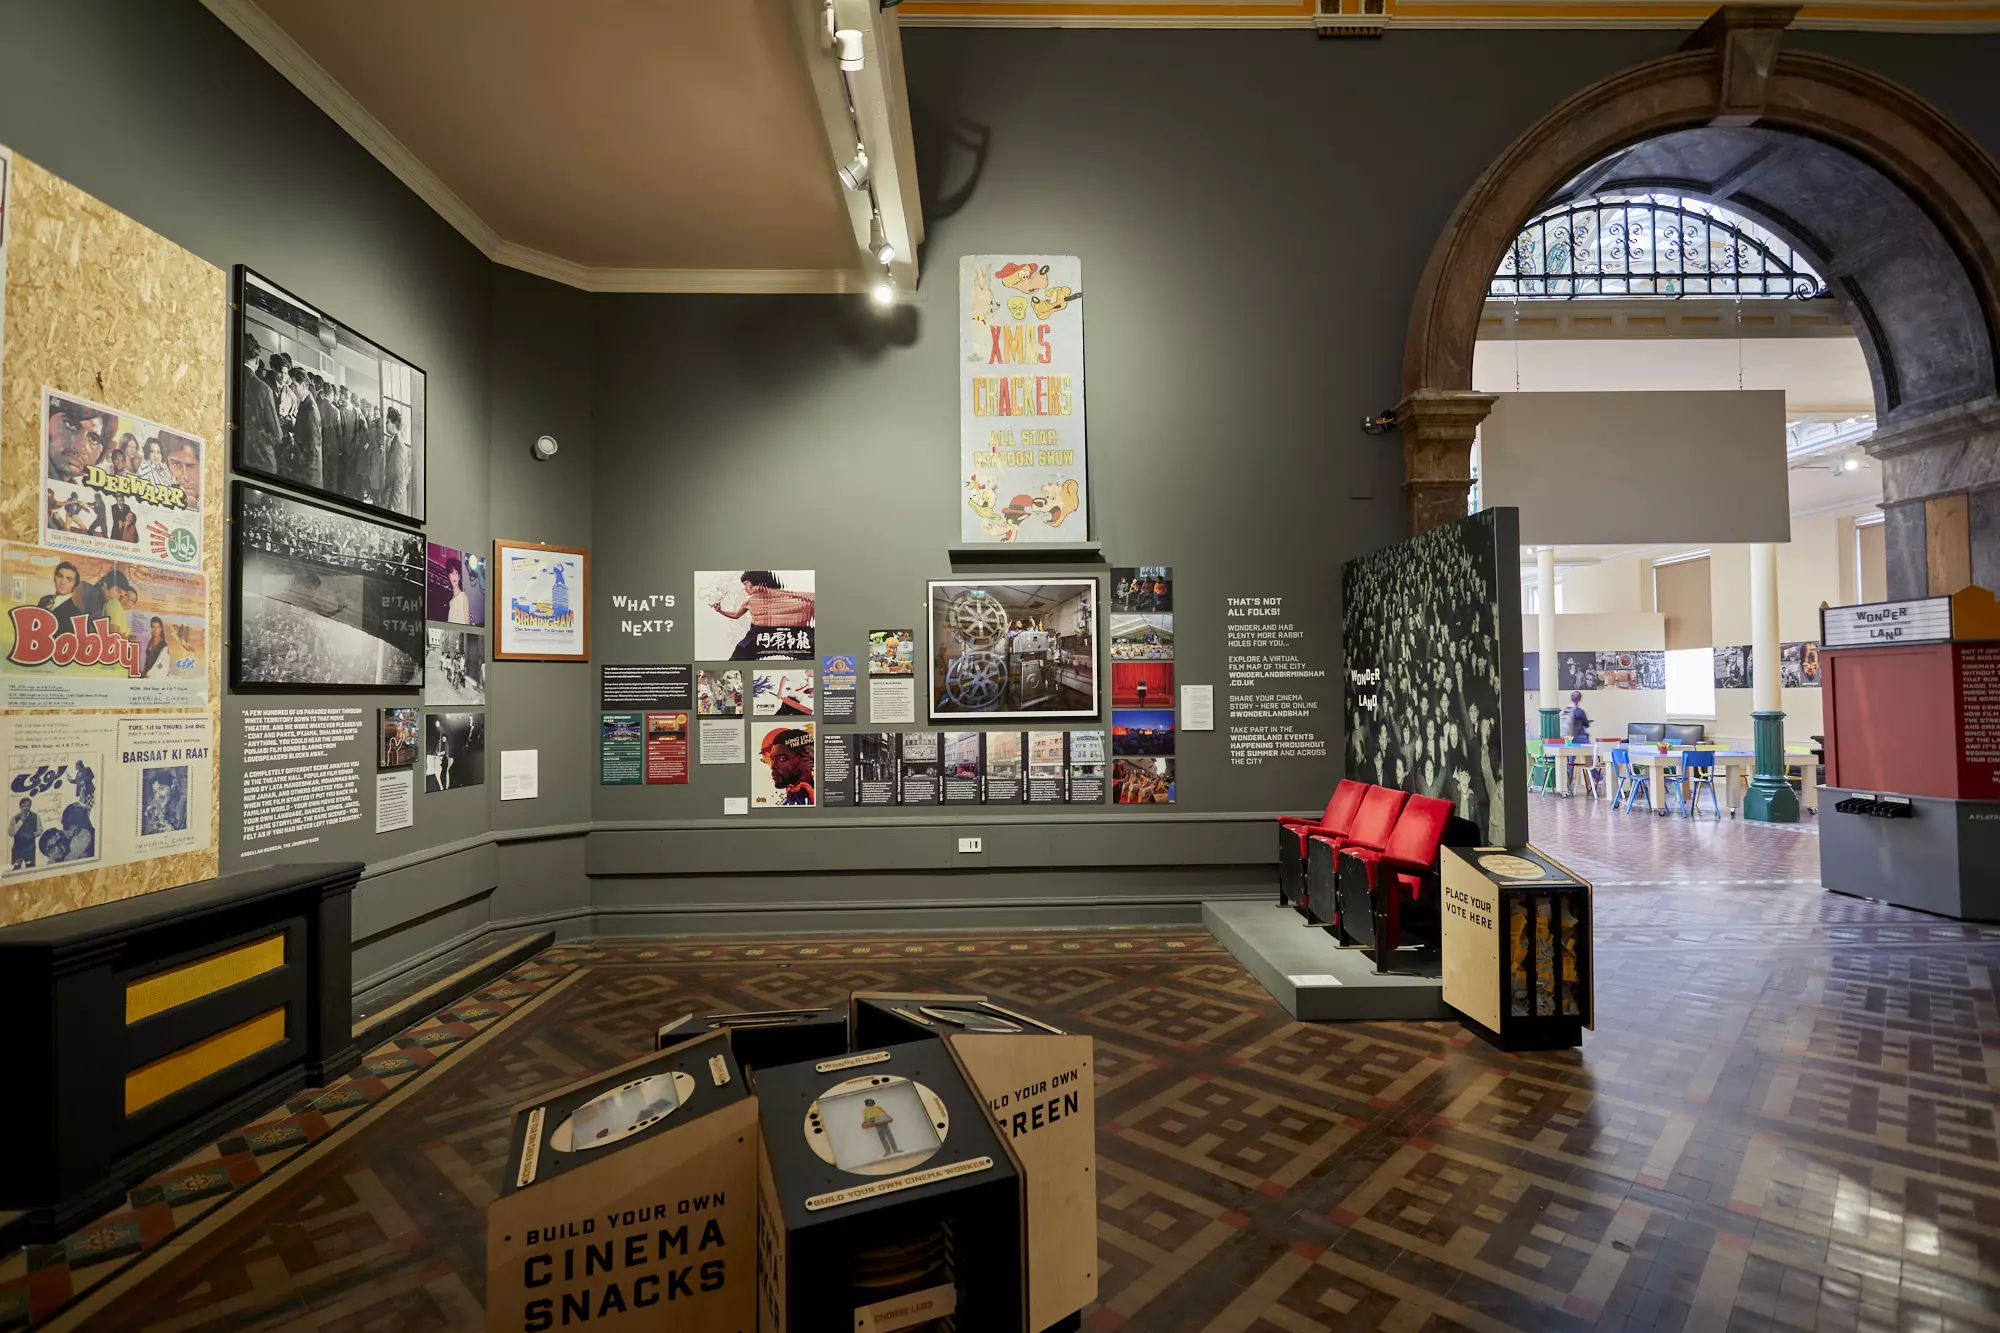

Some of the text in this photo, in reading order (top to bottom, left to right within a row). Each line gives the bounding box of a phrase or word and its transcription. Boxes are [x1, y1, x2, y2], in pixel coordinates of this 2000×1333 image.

[988, 323, 1052, 364] XMAS
[973, 374, 1072, 417] CRACKERS
[989, 429, 1058, 446] ALL STAR
[974, 450, 1074, 468] CARTOON SHOW
[84, 465, 187, 510] DEEWAAR
[612, 595, 675, 612] WHAT'S
[514, 608, 574, 628] BIRMINGHAM
[1856, 608, 1908, 622] WONDER
[622, 620, 674, 636] NEXT?
[1870, 628, 1902, 640] LAND
[8, 605, 141, 678] Bobby
[1352, 668, 1380, 686] WONDER
[1358, 695, 1377, 711] LAND
[785, 736, 799, 745] LONG
[123, 748, 208, 763] BARSAAT KI RAAT
[244, 753, 288, 763] LOUDSPEAKERS
[249, 768, 285, 777] COMPLETELY
[286, 765, 312, 774] DIFFERENT
[1446, 887, 1491, 913] PLACE YOUR
[1446, 902, 1492, 929] VOTE HERE
[823, 1053, 884, 1070] WONDERLAND
[989, 1069, 1078, 1111] ILD YOUR OWN
[814, 1160, 986, 1207] BUILD YOUR OWN CINEMA WORKER
[527, 1192, 725, 1245] BUILD YOUR OWN
[524, 1219, 726, 1289] CINEMA
[524, 1260, 725, 1333] SNACKS
[874, 1307, 908, 1324] CHOOSE
